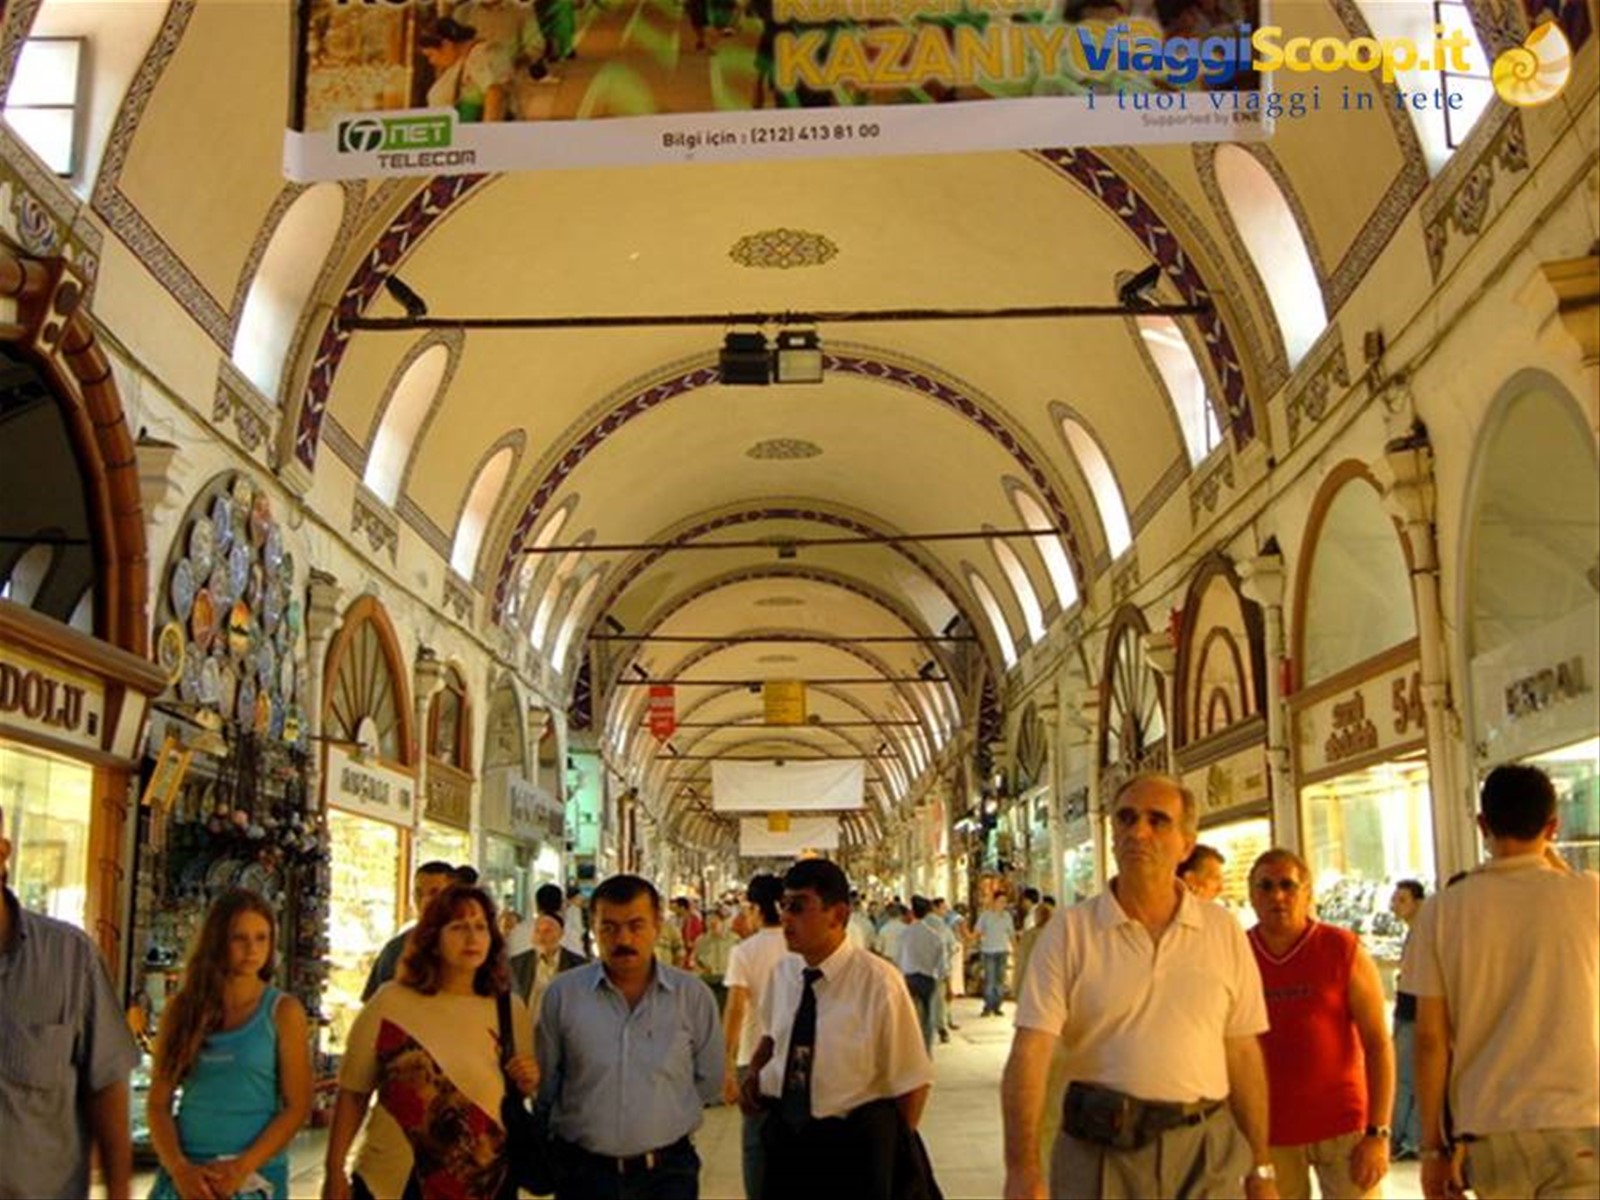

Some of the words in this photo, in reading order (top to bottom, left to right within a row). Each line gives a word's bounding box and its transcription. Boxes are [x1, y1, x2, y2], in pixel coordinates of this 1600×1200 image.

[662, 132, 702, 150] Bilgi
[706, 130, 737, 147] için
[751, 125, 795, 143] (212)
[798, 124, 830, 141] 413
[834, 123, 854, 140] 81
[858, 123, 881, 138] 00
[376, 150, 478, 169] TELECOM
